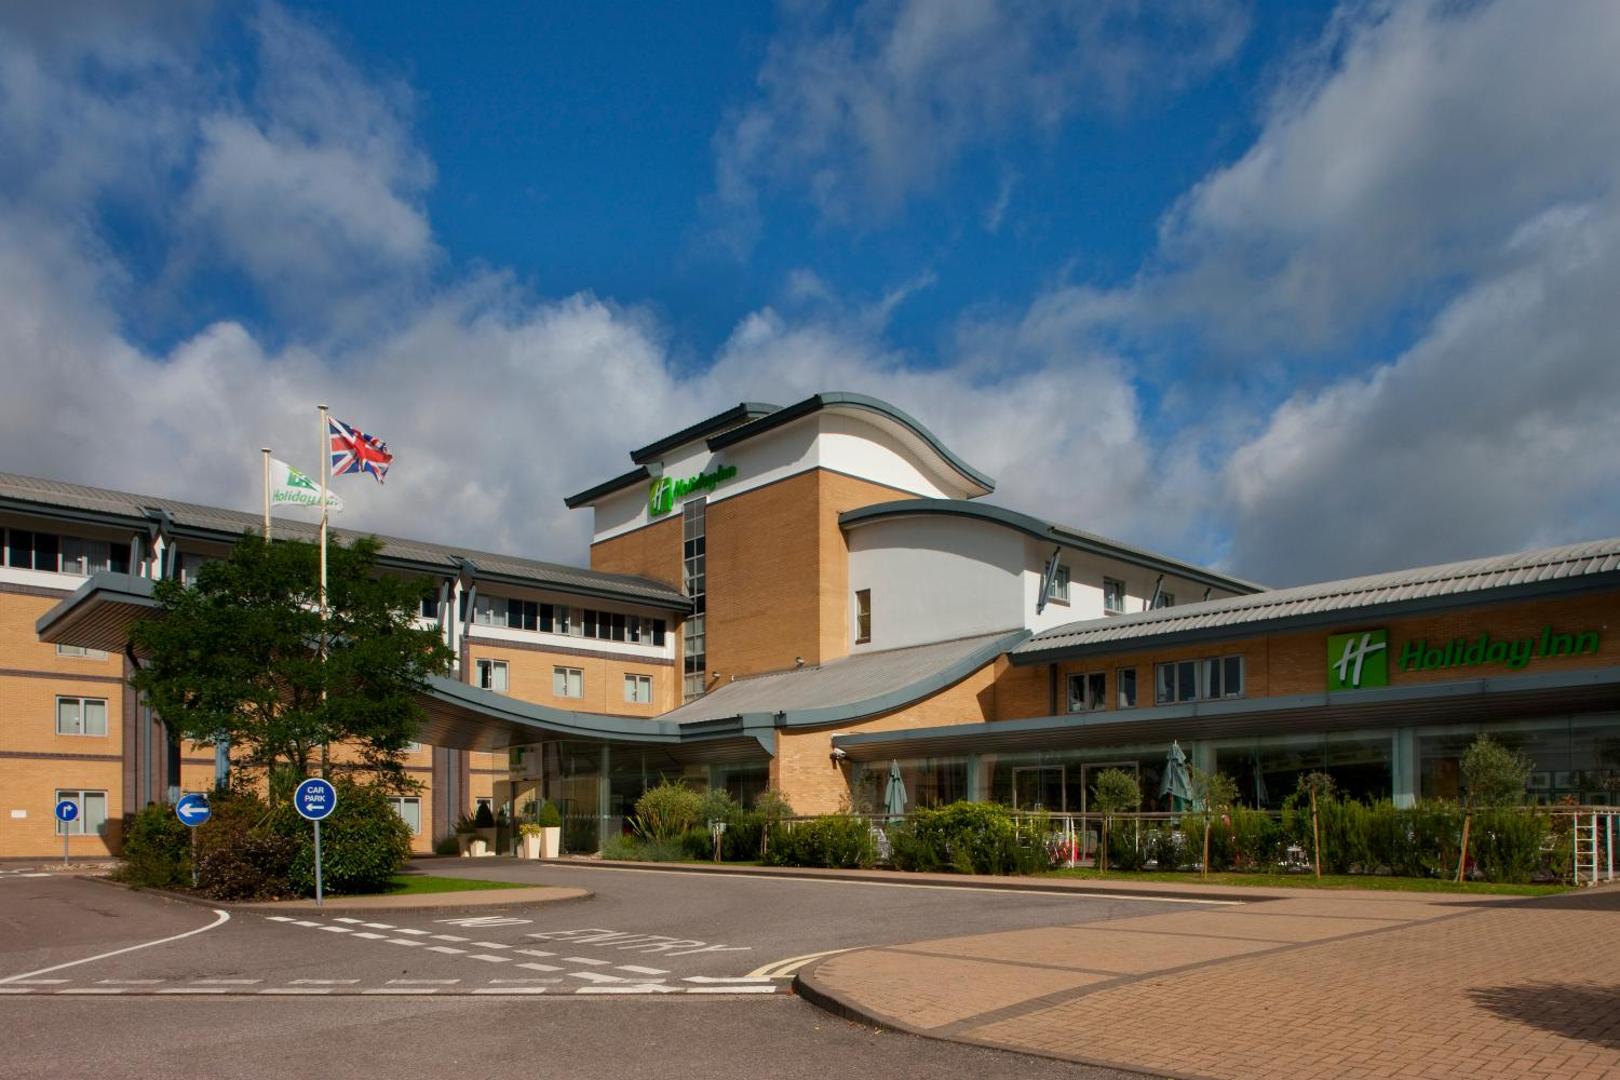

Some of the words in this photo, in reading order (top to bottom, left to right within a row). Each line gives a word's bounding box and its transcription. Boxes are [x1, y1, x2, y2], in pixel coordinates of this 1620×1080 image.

[272, 488, 316, 505] Holiday
[1398, 632, 1534, 670] Holiday
[1539, 624, 1600, 657] Inn
[304, 794, 326, 802] PARK
[307, 786, 325, 794] CAR
[525, 928, 752, 957] ENTRY
